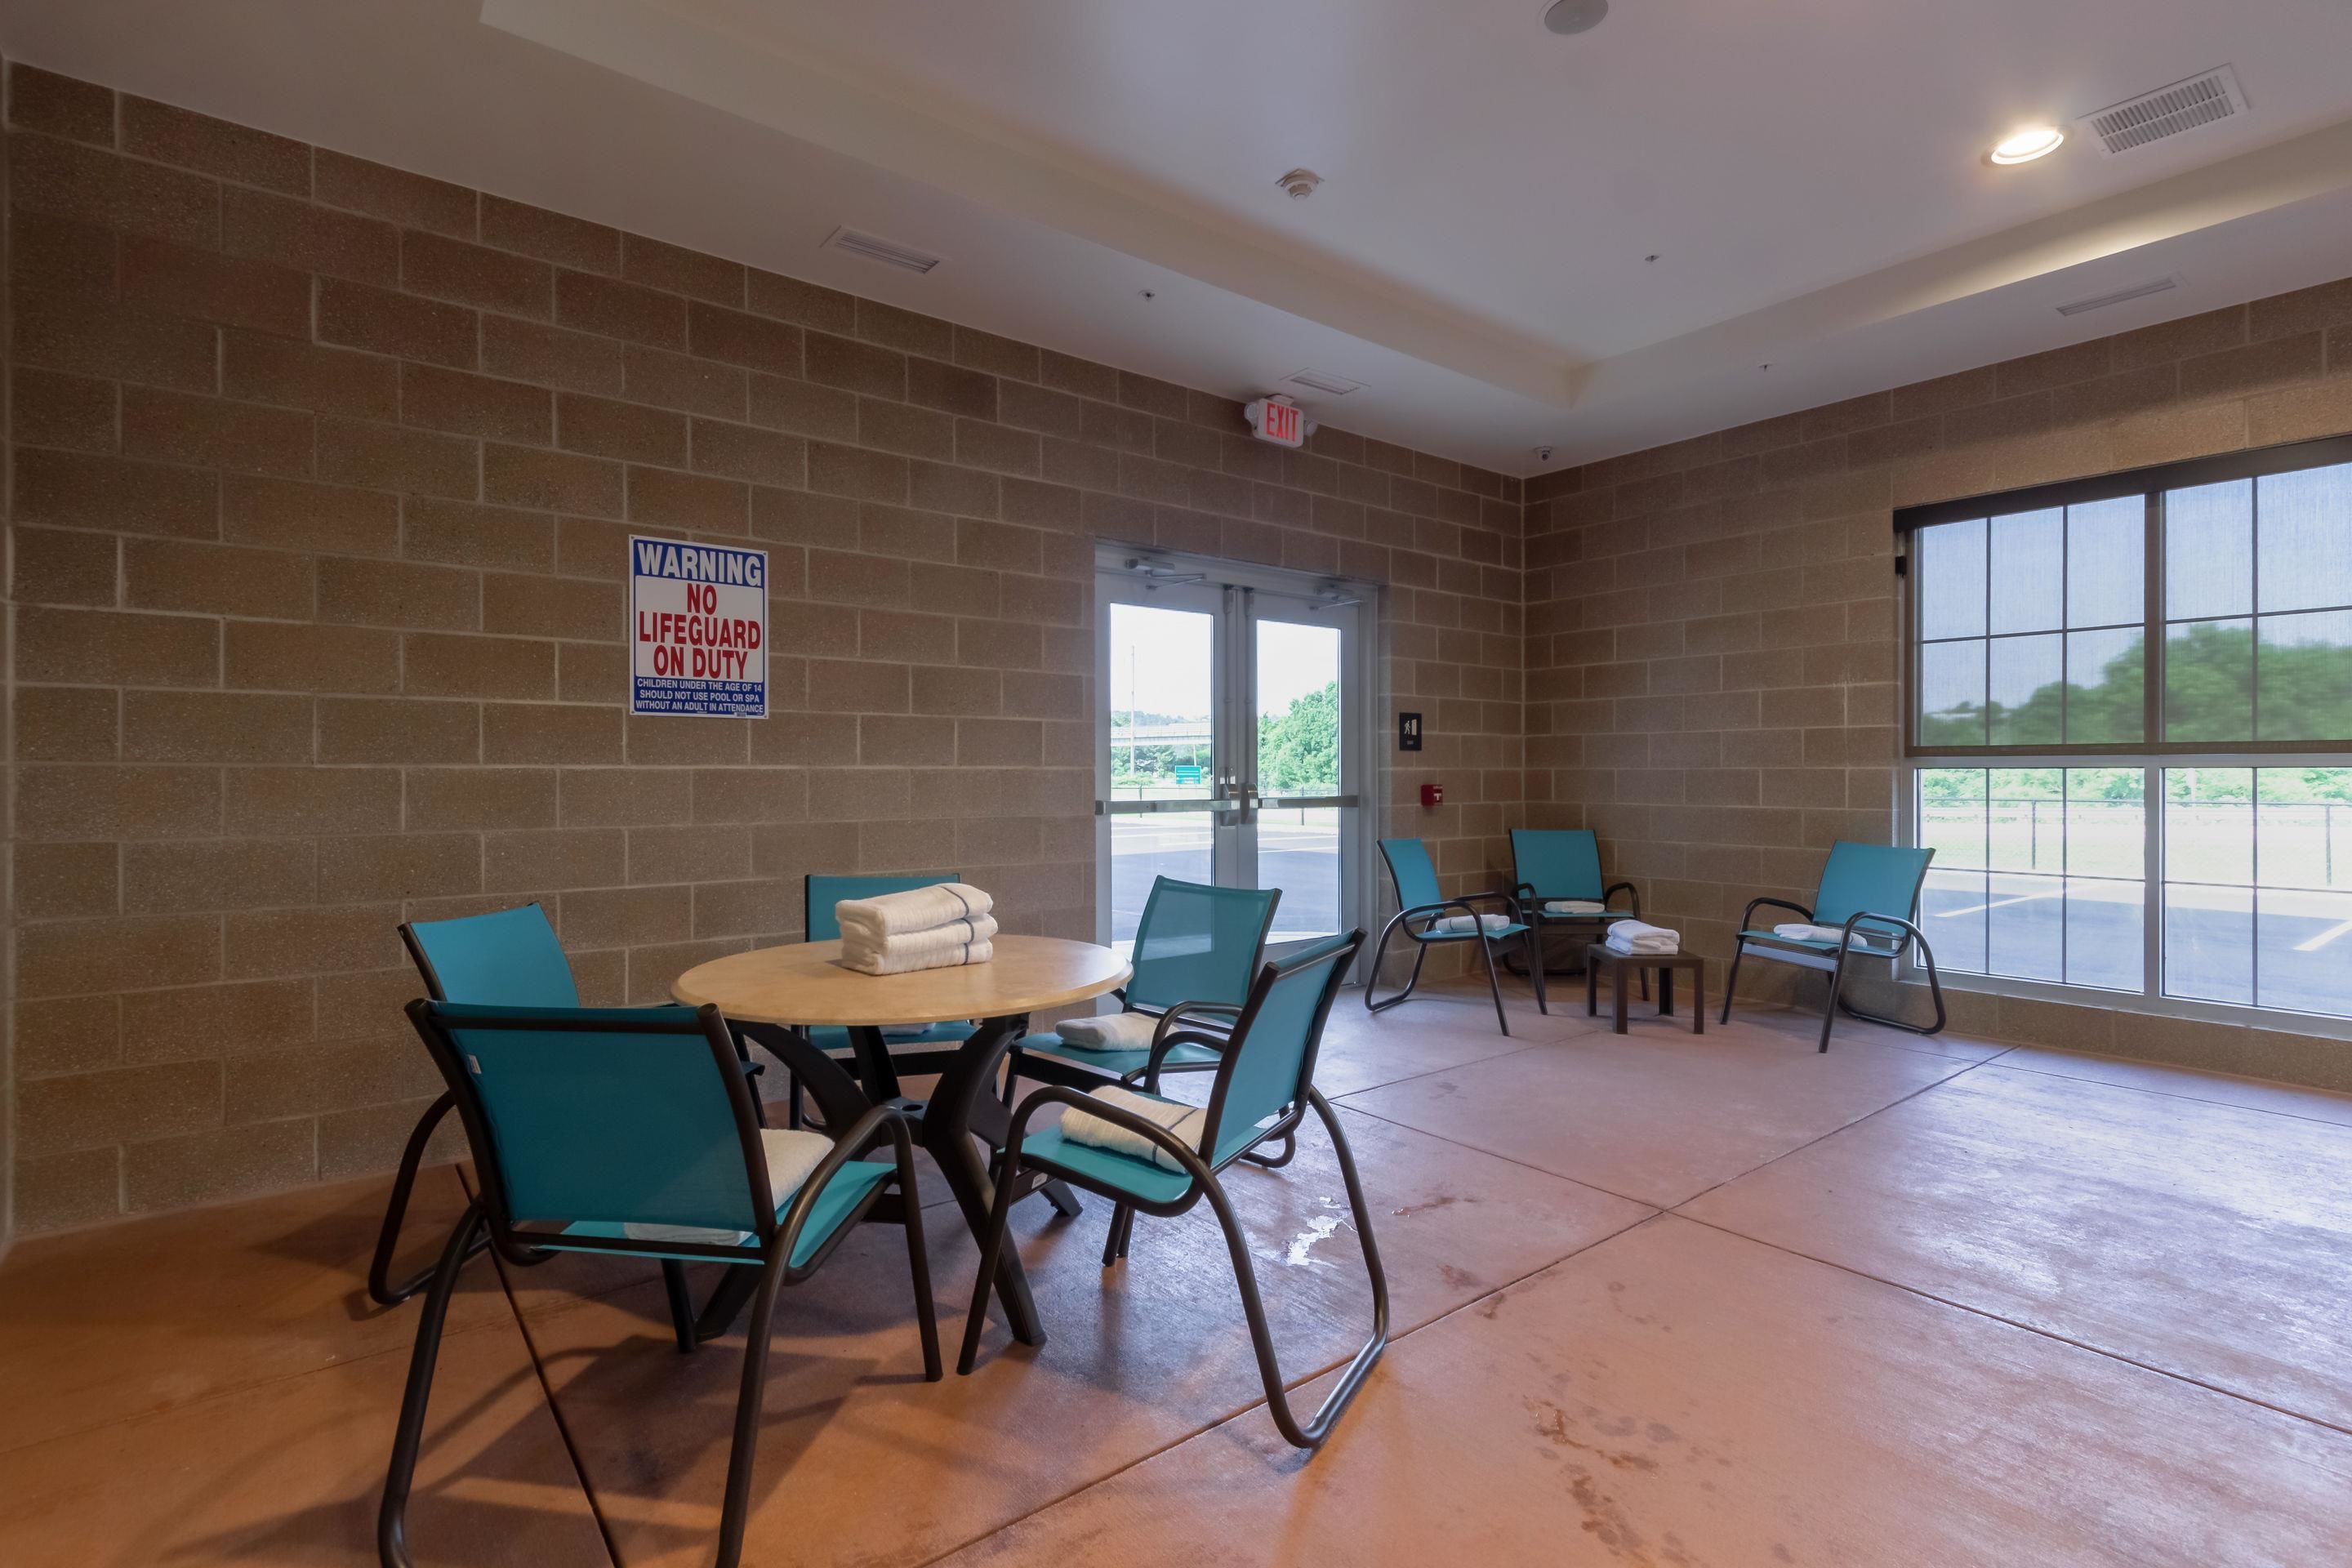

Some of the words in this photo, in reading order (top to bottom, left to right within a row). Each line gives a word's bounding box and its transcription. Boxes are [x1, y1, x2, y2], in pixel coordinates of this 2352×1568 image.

[1267, 402, 1298, 442] EXIT
[637, 543, 761, 586] WARNING
[688, 583, 717, 615] NO
[639, 611, 761, 649] LIFEGUARD
[653, 645, 684, 676] ON
[693, 648, 748, 679] DUTY
[637, 679, 677, 688] CHILDREN
[679, 680, 706, 689] UNDER
[708, 681, 723, 690] THE
[725, 683, 740, 691] AGE
[742, 684, 751, 692] OF
[754, 684, 762, 693] 14
[639, 689, 673, 699] SHOULD
[675, 691, 691, 700] NOT
[693, 692, 708, 701] USE
[710, 693, 731, 702] POOL
[733, 693, 743, 702] OR
[745, 694, 760, 702] SPA
[635, 700, 670, 710] WITHOUT
[672, 702, 682, 710] AN
[684, 702, 708, 710] ADULT
[709, 703, 716, 711] IN
[719, 703, 764, 713] ATTENDANCE
